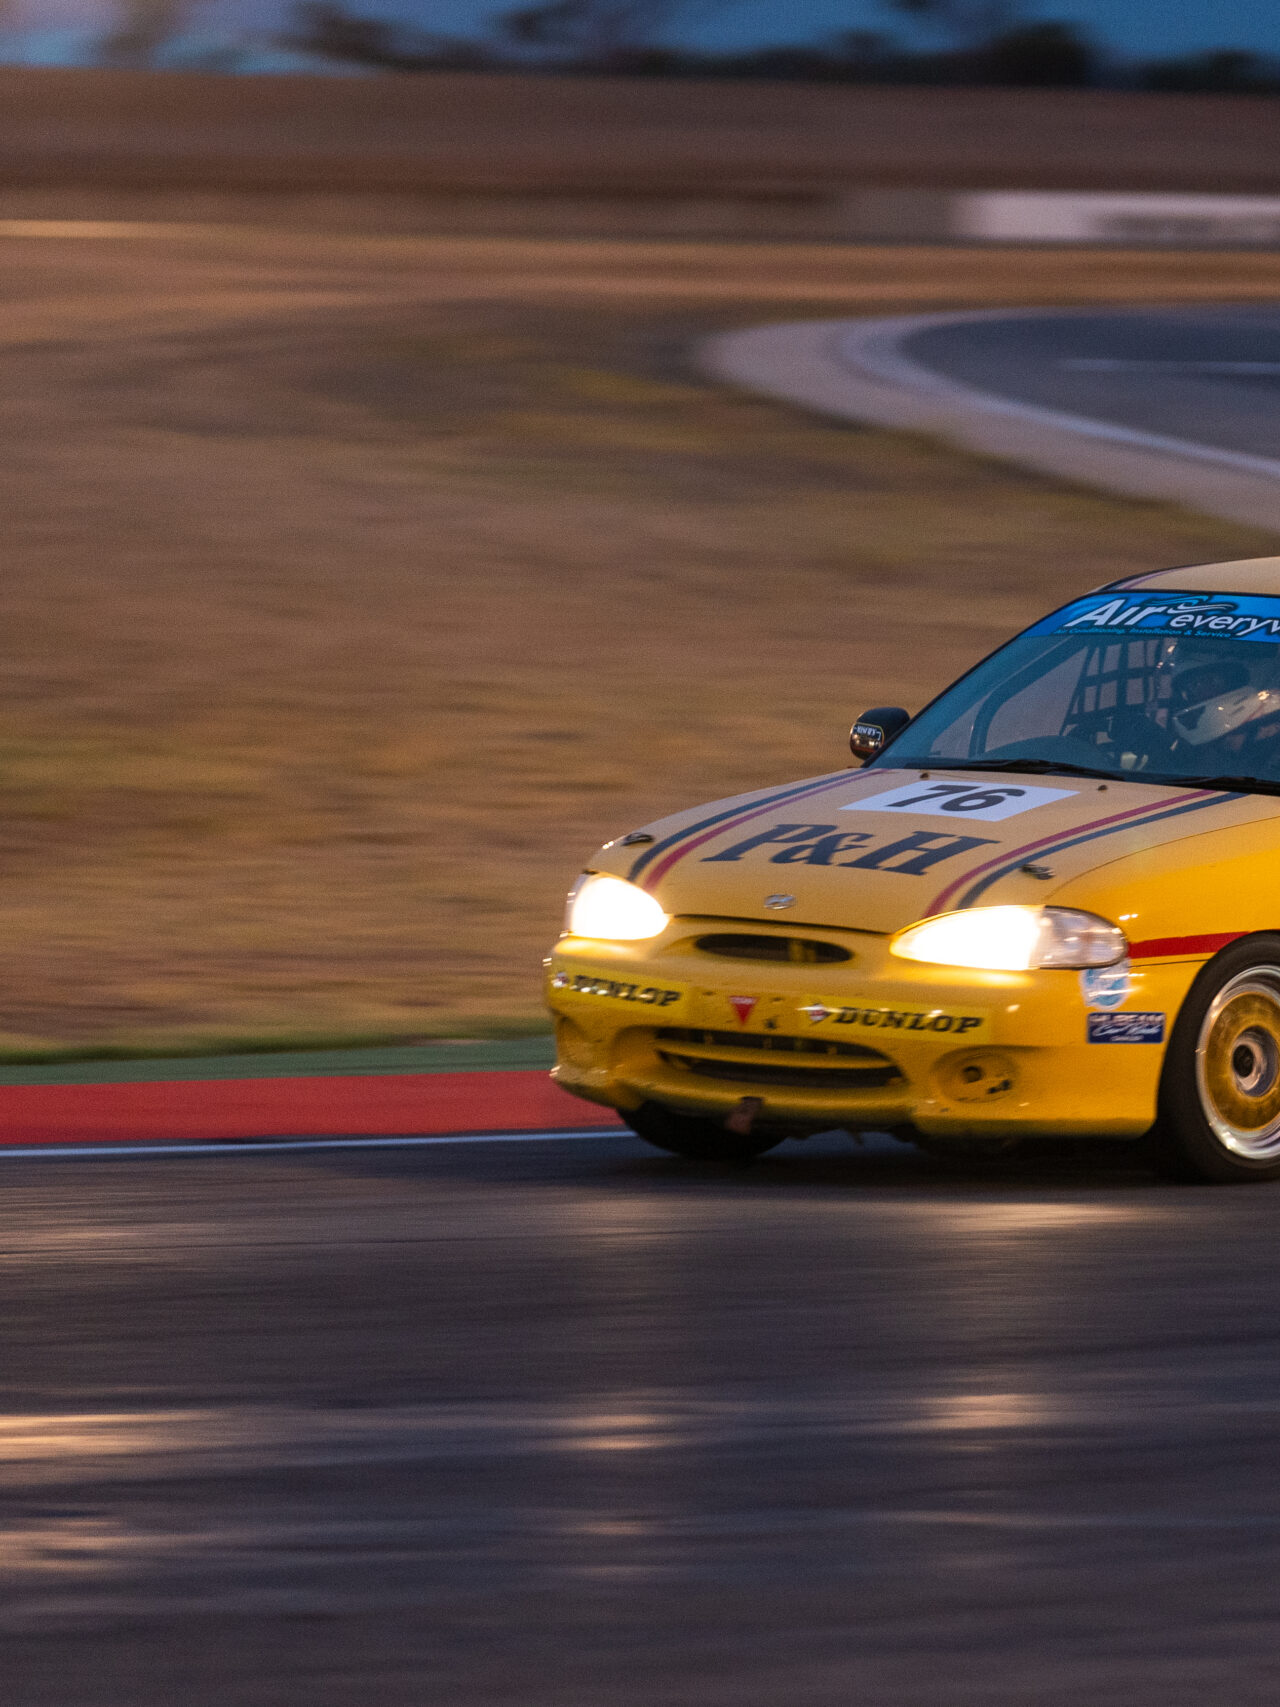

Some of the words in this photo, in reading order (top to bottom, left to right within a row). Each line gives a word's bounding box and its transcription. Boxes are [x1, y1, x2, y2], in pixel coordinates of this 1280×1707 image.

[1062, 599, 1168, 627] Air
[884, 784, 1027, 812] 76
[699, 823, 1003, 876] P&H
[573, 974, 683, 1006] DUNLOP
[831, 1006, 985, 1033] DUNLOP
